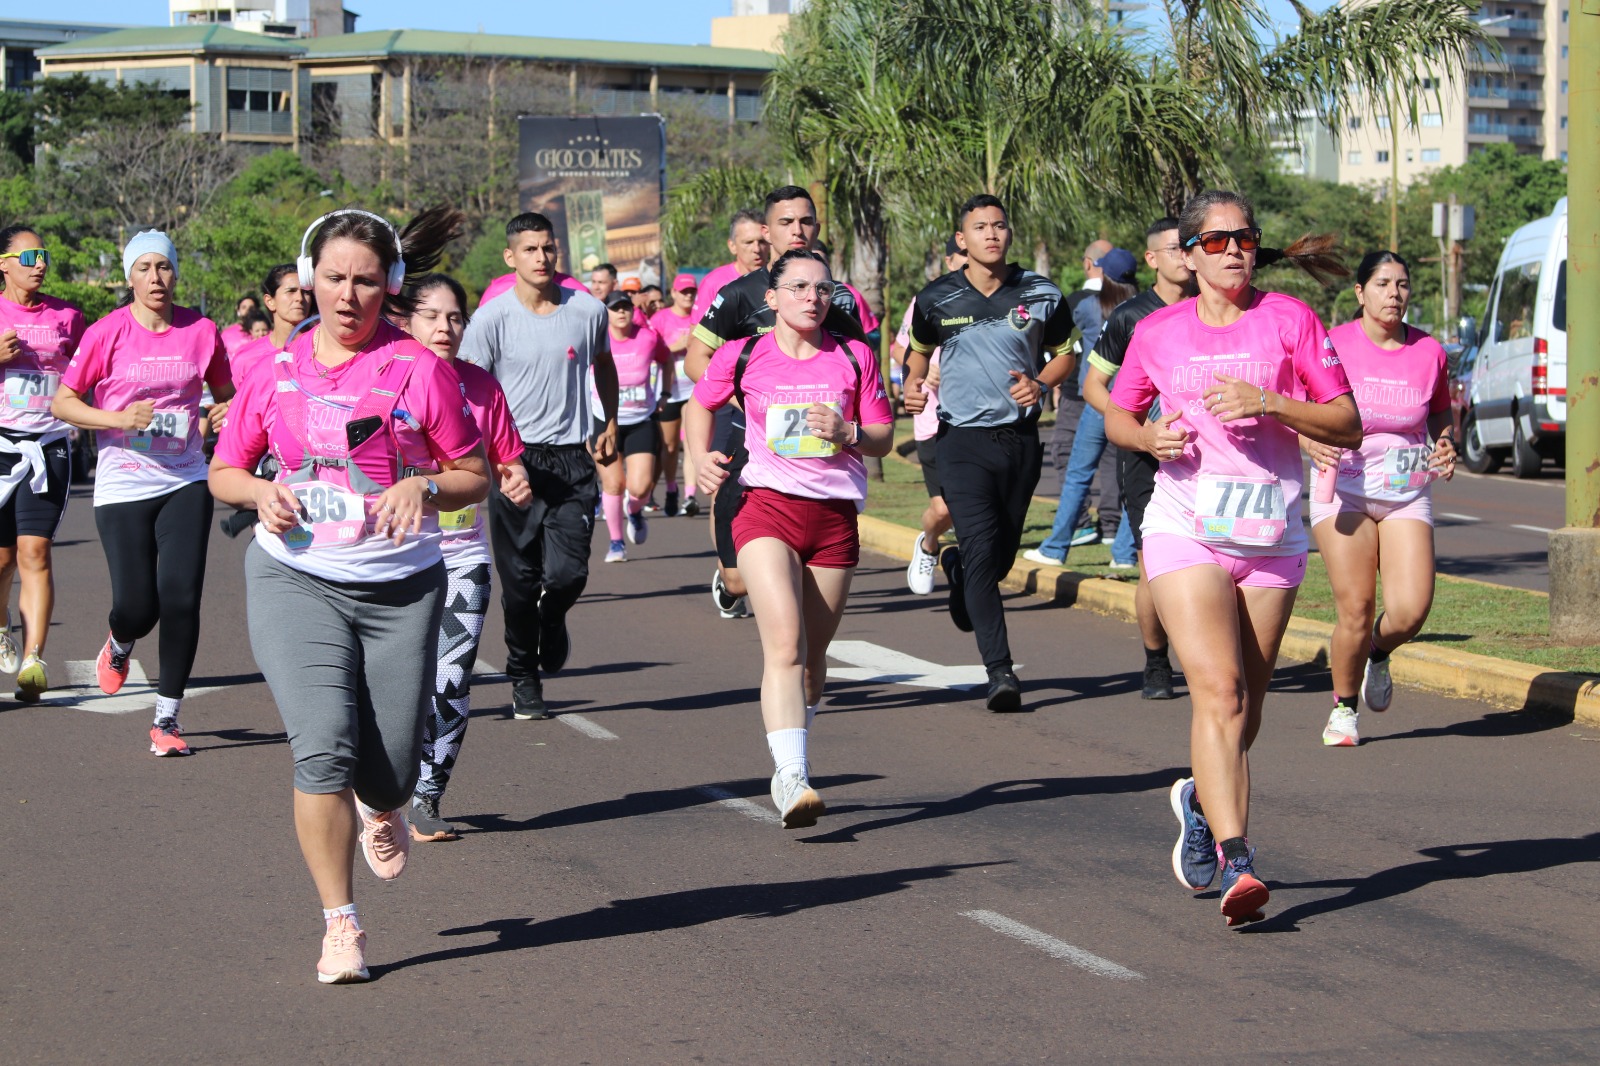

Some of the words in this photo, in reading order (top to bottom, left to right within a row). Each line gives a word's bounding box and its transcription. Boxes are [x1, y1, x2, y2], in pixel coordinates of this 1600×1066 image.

[535, 148, 642, 169] CHOCOLATES
[941, 316, 969, 326] Comisión
[968, 315, 974, 323] A
[126, 361, 198, 383] ACTITUD
[19, 373, 49, 397] 731
[138, 413, 177, 437] 39
[1396, 446, 1431, 474] 579
[1215, 481, 1274, 519] 774
[456, 513, 467, 524] 5k
[337, 526, 356, 539] 10k
[1258, 524, 1277, 537] 10k
